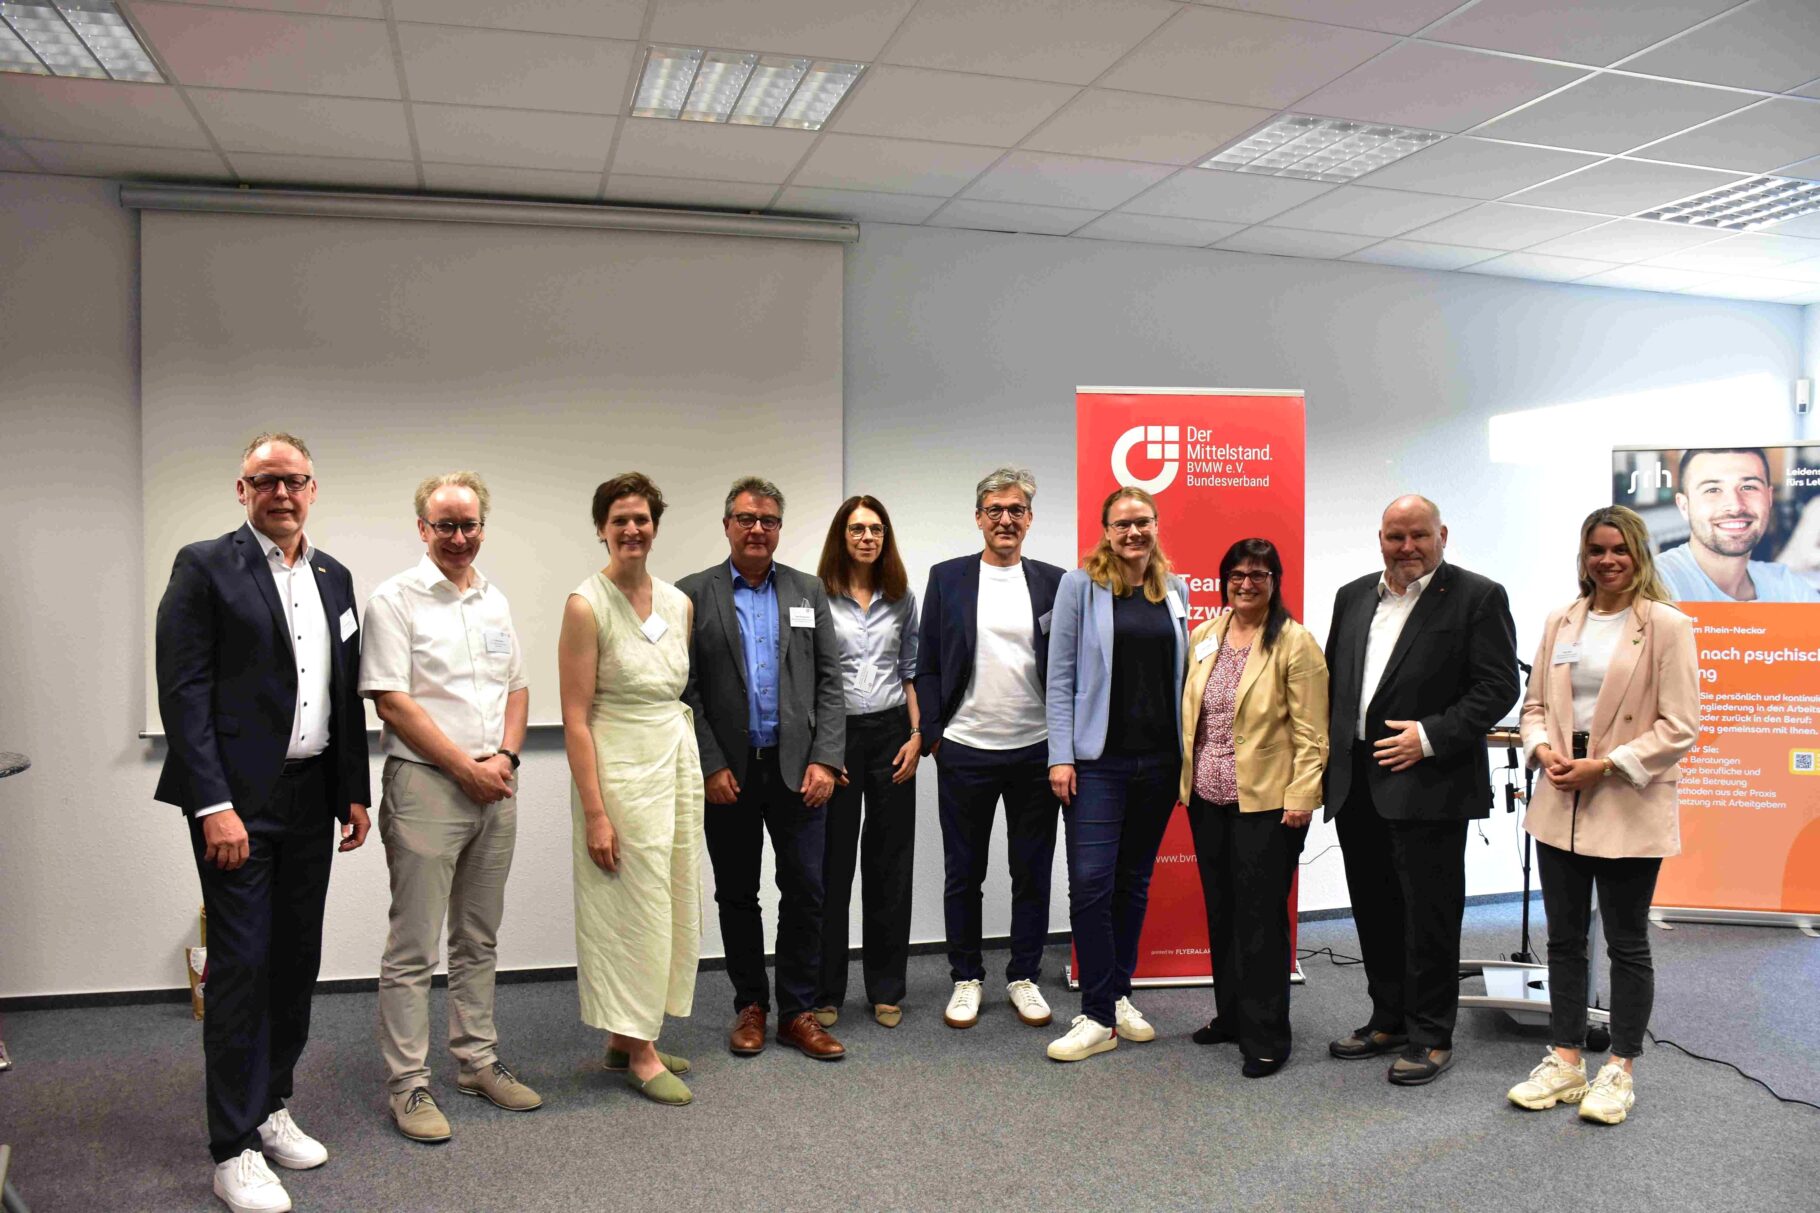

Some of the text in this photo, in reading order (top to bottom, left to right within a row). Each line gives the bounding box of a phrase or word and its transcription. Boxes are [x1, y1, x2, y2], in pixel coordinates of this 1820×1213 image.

[1187, 426, 1212, 442] Der
[1187, 444, 1273, 460] Mittelstand.
[1187, 462, 1223, 473] BVMW
[1187, 475, 1270, 487] Bundesverband
[1187, 603, 1232, 620] tzwe
[1704, 626, 1766, 634] Rhein-Neckar
[1700, 646, 1740, 660] nach
[1716, 692, 1762, 701] persönlich
[1700, 703, 1754, 713] ngliederung
[1766, 704, 1784, 712] den
[1786, 705, 1820, 713] Arbeits
[1722, 714, 1752, 722] zurück
[1764, 715, 1781, 723] den
[1717, 725, 1771, 734] gemeinsam
[1690, 756, 1740, 766] Beratungen
[1698, 767, 1742, 776] berufliche
[1744, 768, 1761, 776] und
[1702, 777, 1748, 788] Betreuung
[1678, 788, 1714, 796] ethoden
[1750, 790, 1776, 798] Praxis
[1728, 799, 1787, 810] Arbeitgebern
